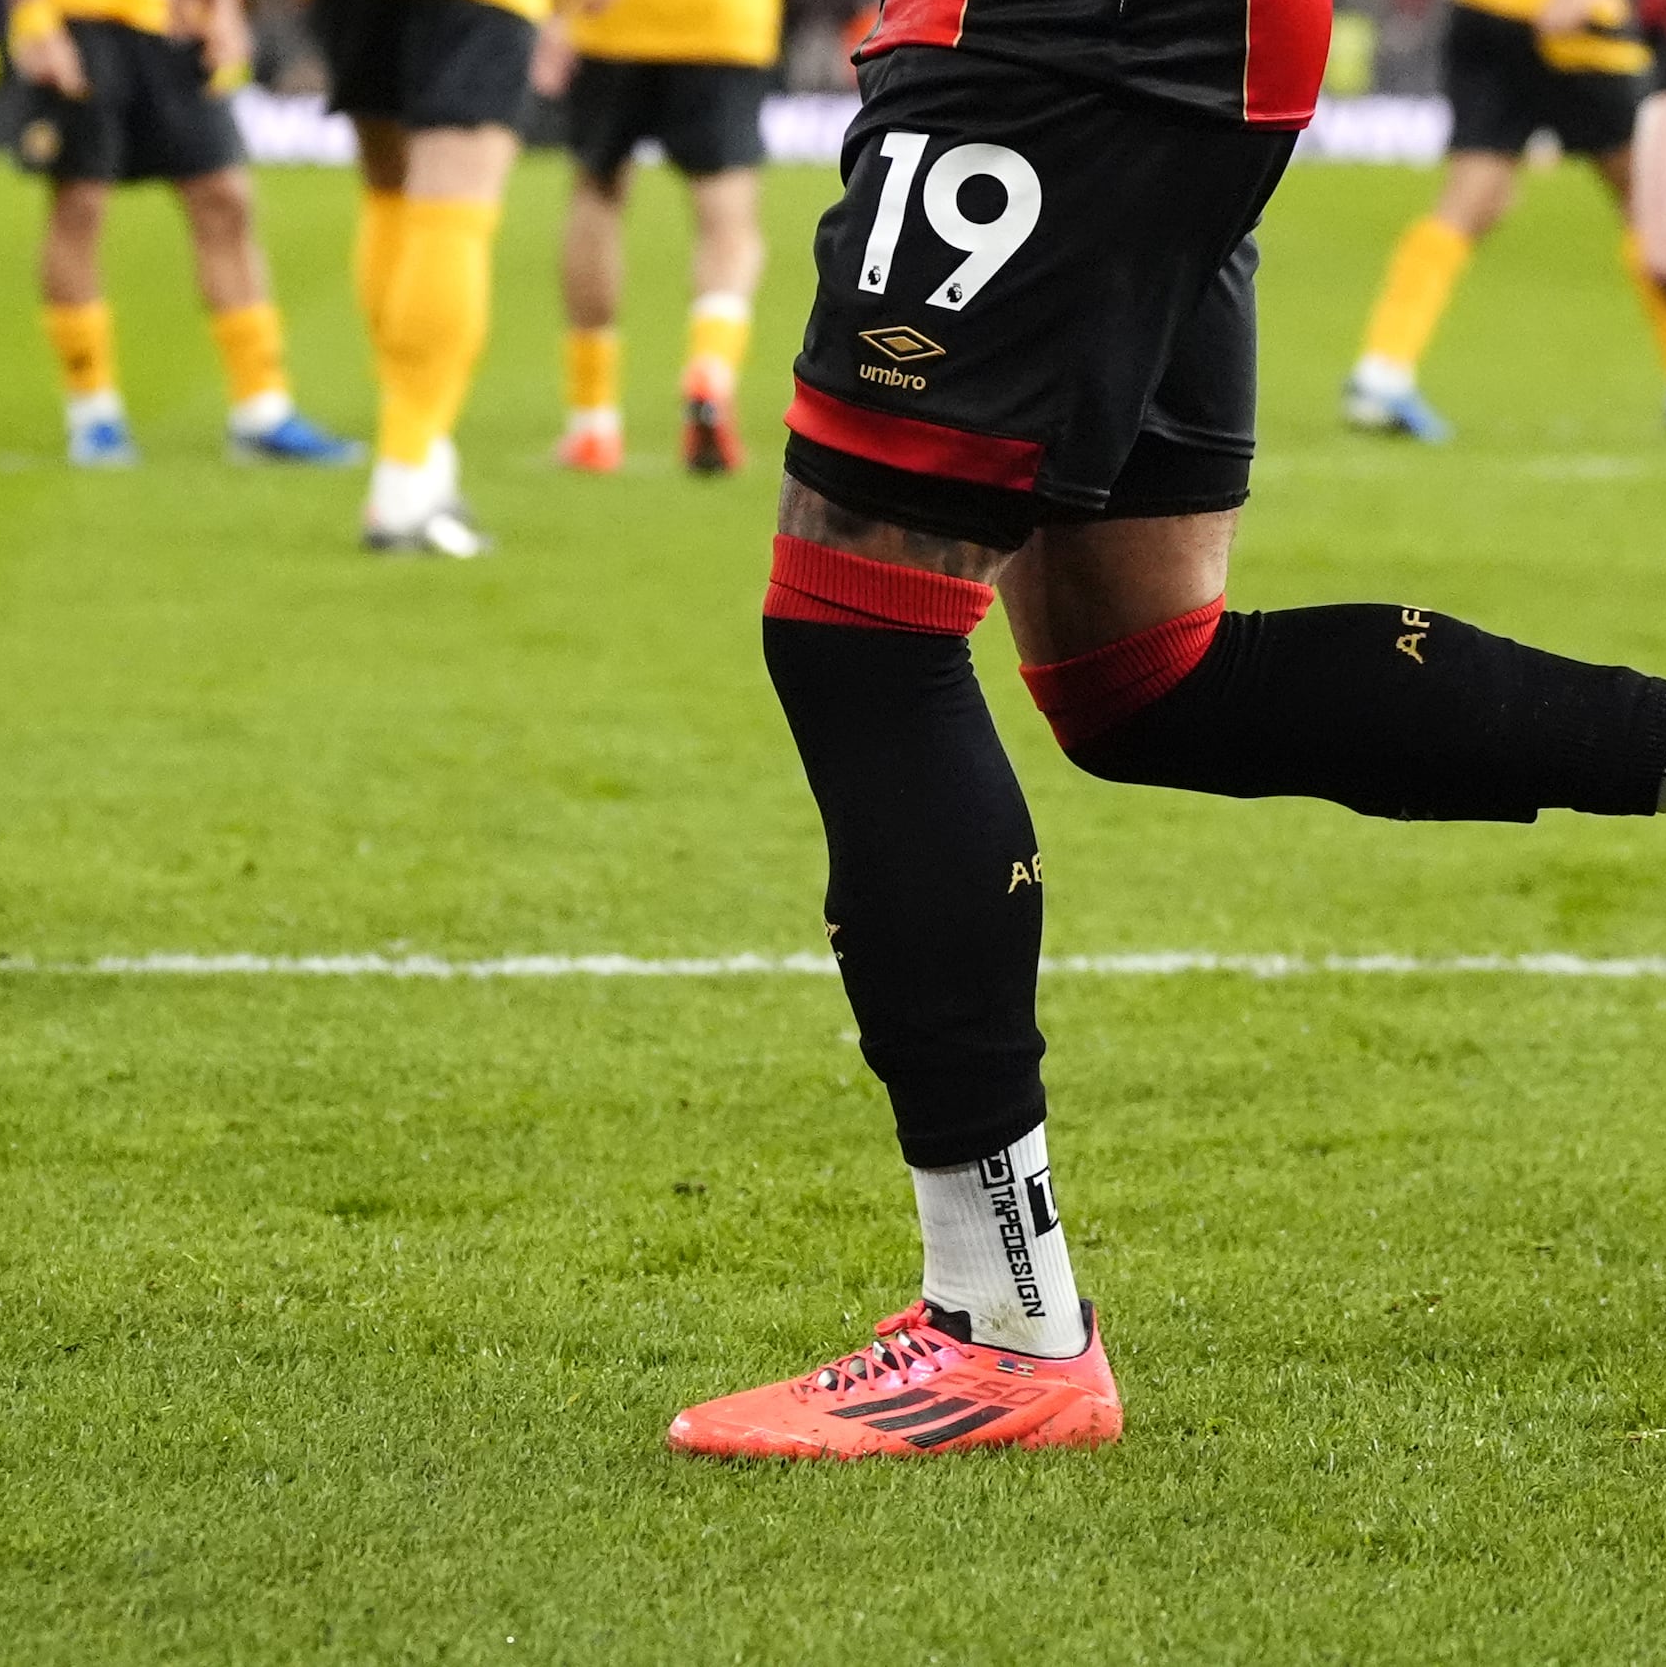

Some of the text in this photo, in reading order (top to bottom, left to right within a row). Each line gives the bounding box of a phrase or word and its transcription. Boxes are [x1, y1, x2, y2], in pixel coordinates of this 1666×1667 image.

[857, 131, 1042, 312] 19
[859, 363, 927, 391] umbro
[990, 1186, 1046, 1319] TAPEDESIGN
